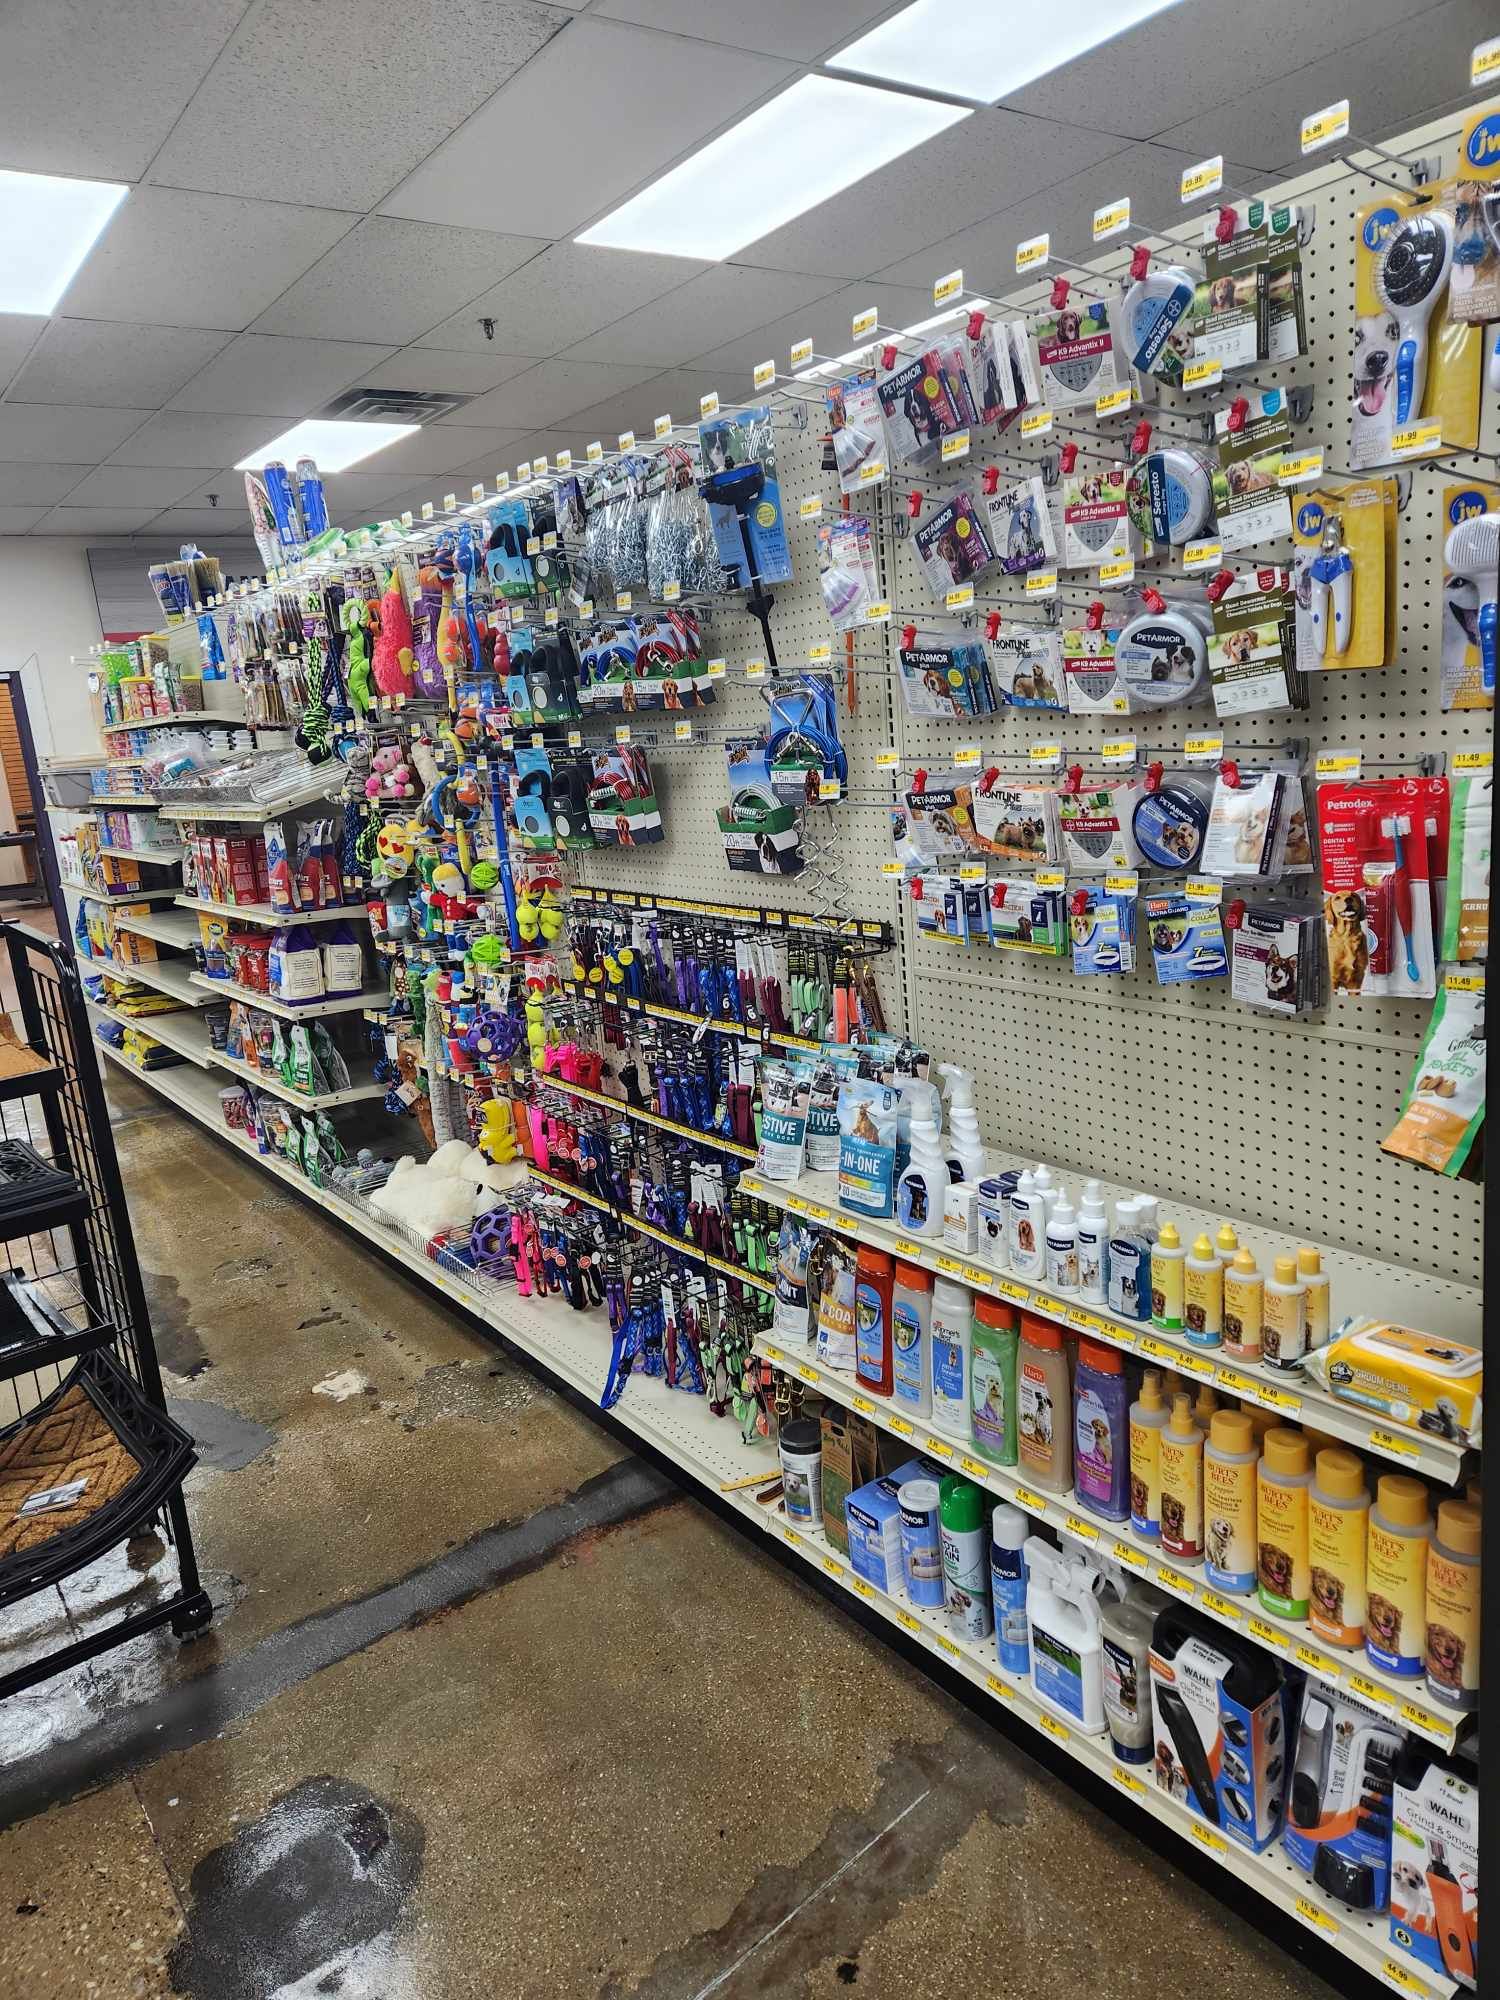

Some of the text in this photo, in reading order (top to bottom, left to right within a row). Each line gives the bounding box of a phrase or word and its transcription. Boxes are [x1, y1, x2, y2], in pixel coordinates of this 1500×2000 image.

[1305, 124, 1322, 137] 5.99
[1145, 317, 1173, 359] Seresto
[1068, 340, 1099, 353] Advantix
[882, 364, 922, 396] PETARMOR
[1394, 431, 1417, 442] 11.99
[1153, 470, 1162, 516] Seresto
[1242, 487, 1270, 501] Dewormer
[1089, 506, 1114, 516] Advantix
[919, 508, 953, 543] PETARMOR
[1304, 513, 1322, 530] jw
[1240, 595, 1266, 607] Dewormer
[992, 639, 1030, 649] FRONTLINE
[1136, 632, 1181, 644] PETARMOR
[905, 652, 948, 664] PETARMOR
[1088, 659, 1115, 668] Advantix
[1238, 661, 1266, 672] Dewormer
[1319, 758, 1335, 767] 9.99
[1456, 753, 1480, 762] 11.49
[911, 794, 952, 805] PETARMOR
[974, 789, 1022, 804] FRONTLINE
[1158, 796, 1194, 824] PETARMOR
[1327, 800, 1374, 811] Petrodex
[1084, 820, 1107, 828] Advantix
[1150, 902, 1168, 910] Hartz
[1251, 919, 1282, 929] PETARMOR
[1448, 976, 1471, 986] 11.49
[763, 1027, 769, 1040] 6
[1024, 1365, 1044, 1381] Hartz
[1374, 1431, 1393, 1444] 5.99
[1211, 1472, 1234, 1485] BEES
[1264, 1495, 1289, 1510] BEES
[1311, 1506, 1344, 1524] BURT'S
[1314, 1516, 1338, 1531] BEES
[1371, 1531, 1405, 1551] BURT'S
[1373, 1541, 1400, 1559] BEES
[1434, 1567, 1464, 1588] BEES
[1184, 1664, 1211, 1688] WAHL
[1320, 1682, 1336, 1697] Pet
[1337, 1691, 1380, 1717] Trimmer
[1406, 1707, 1428, 1723] 10.99
[1430, 1800, 1465, 1828] WAHL
